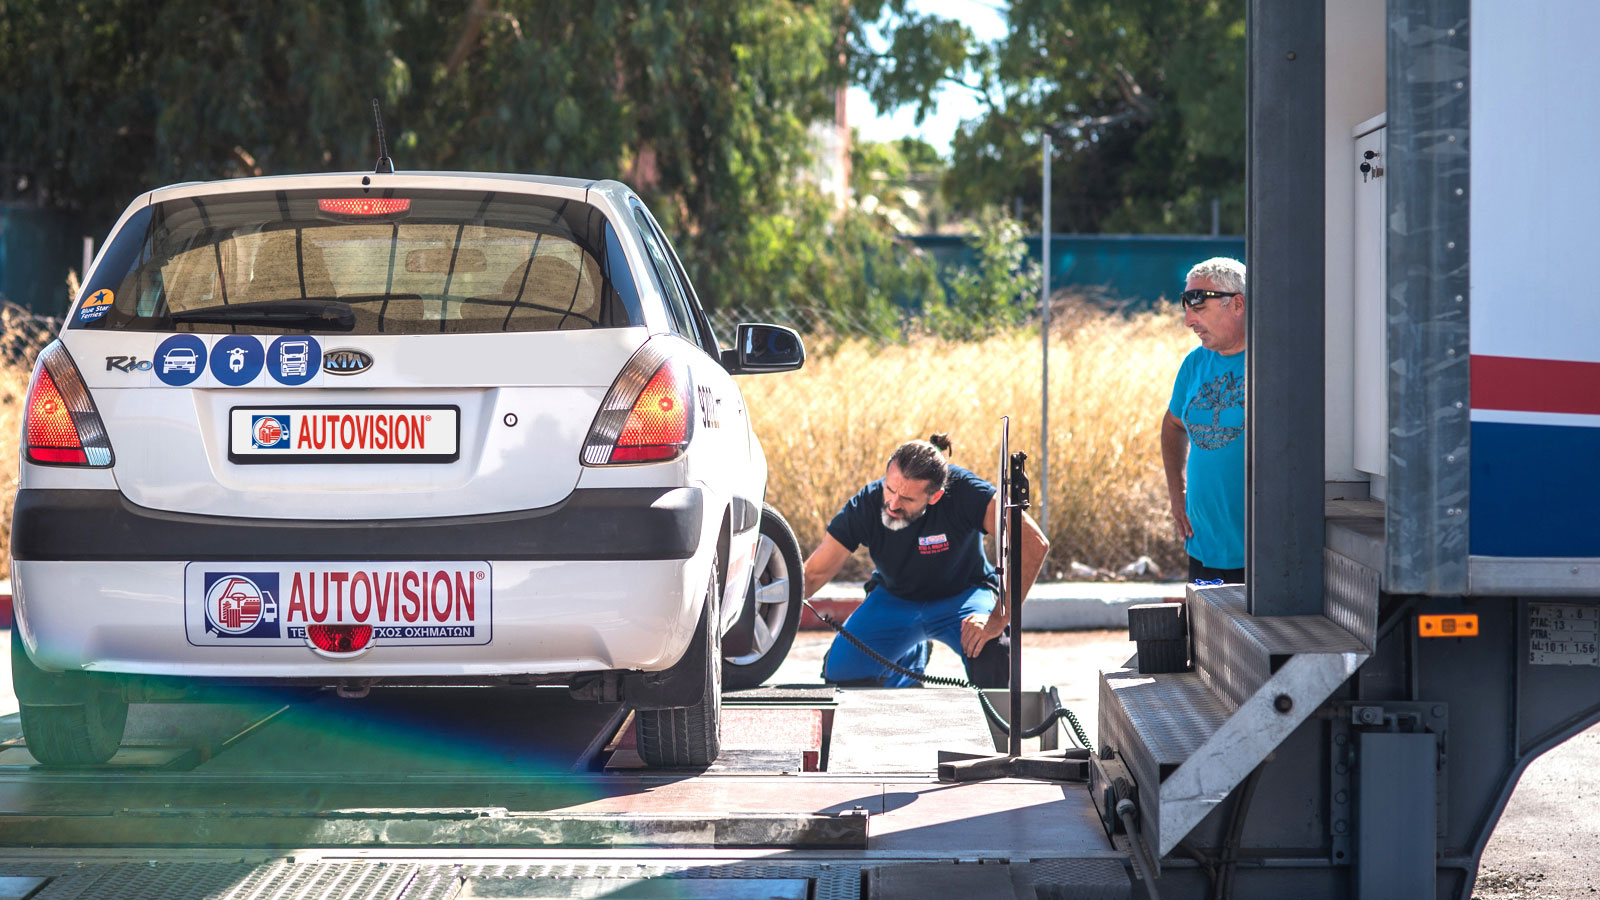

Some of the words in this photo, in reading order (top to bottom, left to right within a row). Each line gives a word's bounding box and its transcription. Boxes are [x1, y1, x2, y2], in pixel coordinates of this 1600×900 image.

[80, 312, 103, 320] Ferries
[105, 356, 153, 373] Rio
[326, 353, 364, 369] KIA
